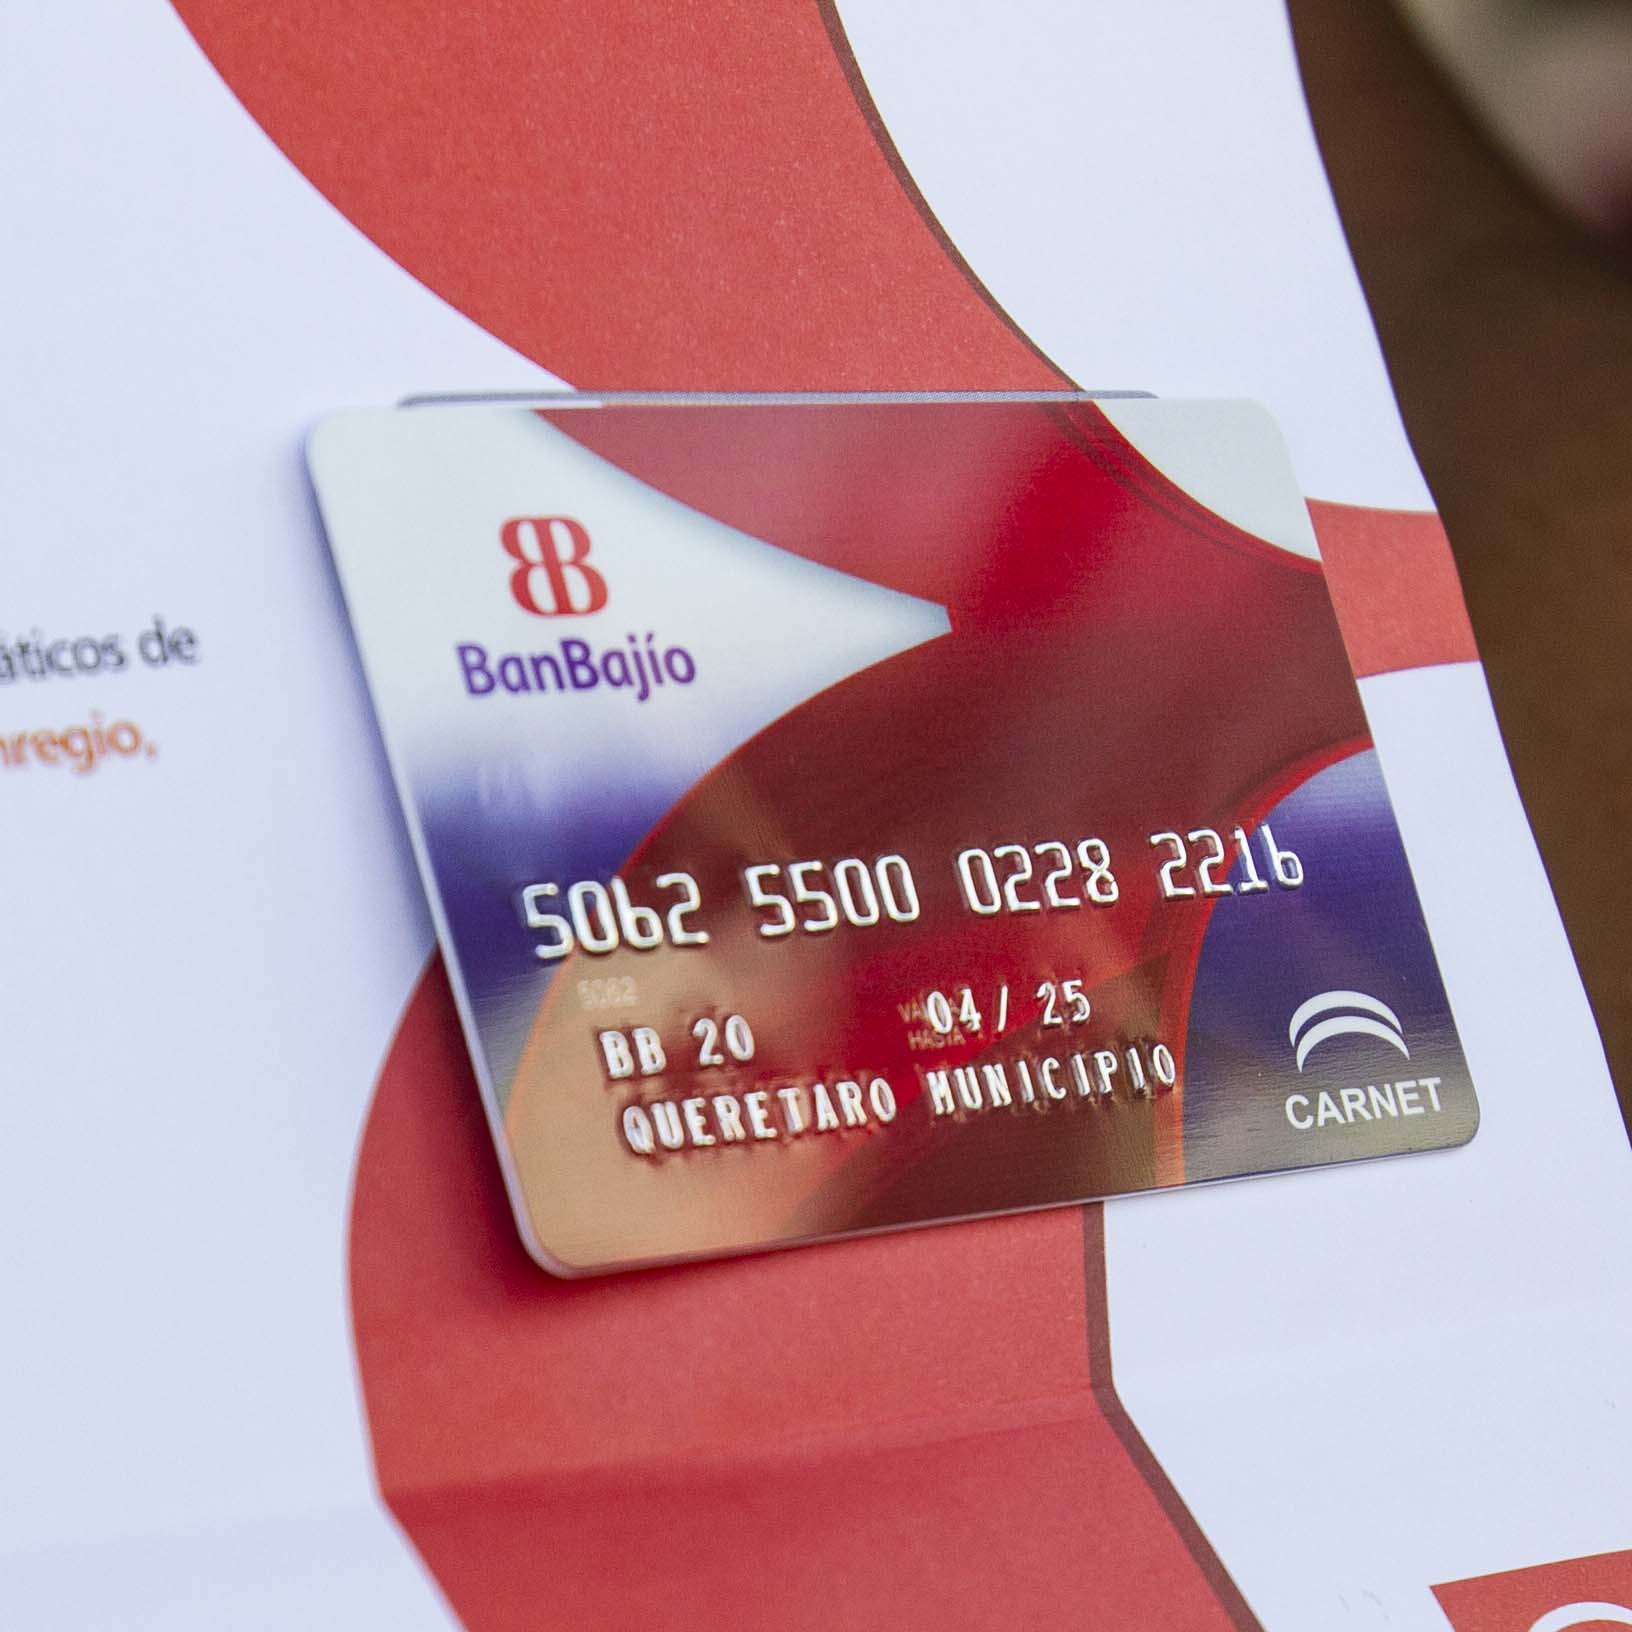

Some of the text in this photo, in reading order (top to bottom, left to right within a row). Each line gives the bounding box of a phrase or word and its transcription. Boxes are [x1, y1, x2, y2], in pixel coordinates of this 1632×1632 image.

[126, 612, 205, 669] de
[455, 631, 697, 703] BanBajío
[522, 822, 1306, 959] 5062 5500 0228 2216
[597, 1012, 758, 1080] BB 20
[619, 1042, 1177, 1157] QUERETARO MUNICIPIO
[1284, 1076, 1442, 1130] CARNET
